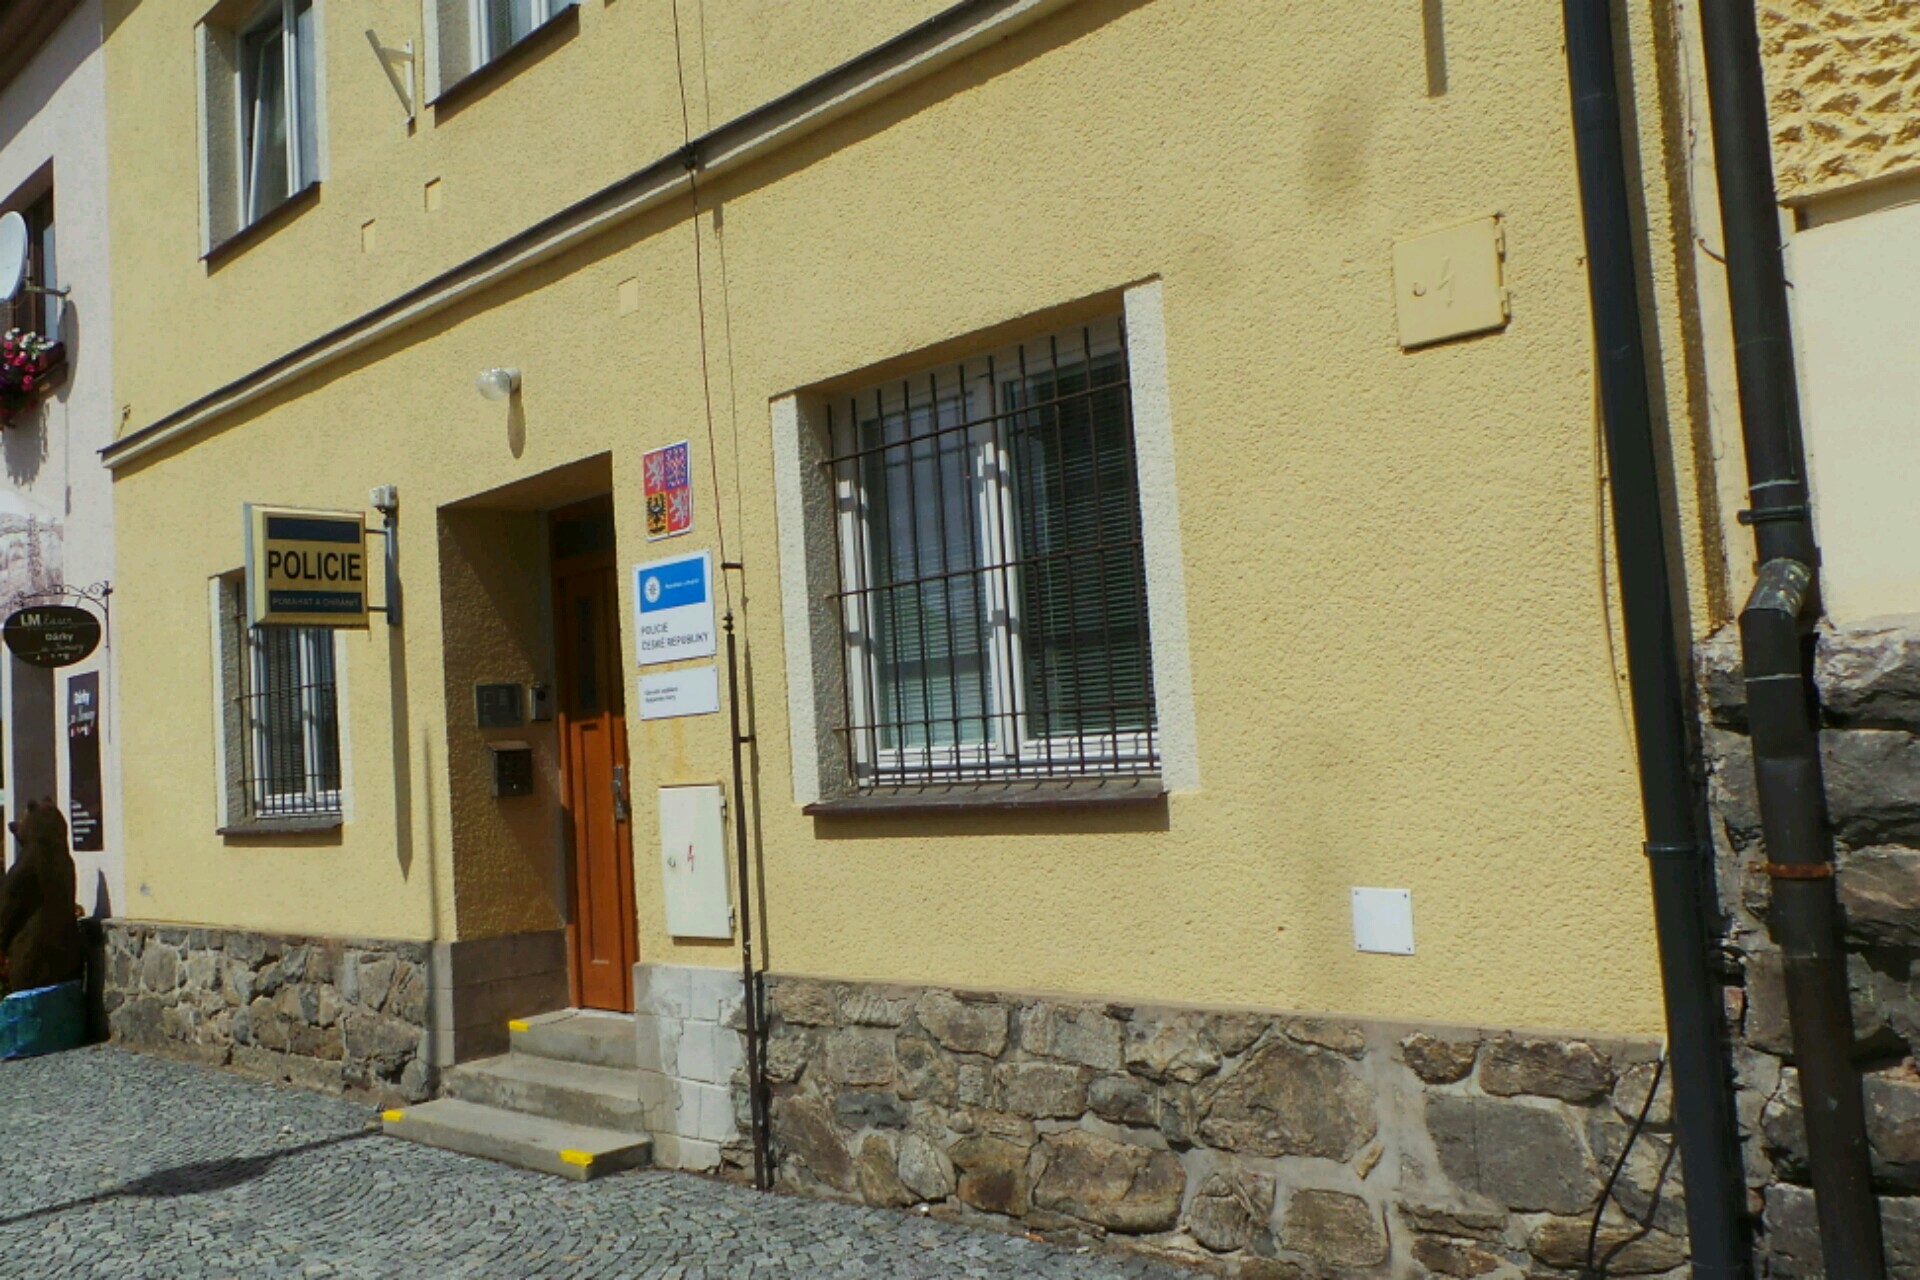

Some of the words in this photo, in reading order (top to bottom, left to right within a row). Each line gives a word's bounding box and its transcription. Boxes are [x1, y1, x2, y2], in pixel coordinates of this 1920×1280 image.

[268, 550, 362, 581] POLICIE
[21, 613, 42, 628] LM
[641, 622, 669, 637] POLICIE
[667, 631, 710, 647] REPUBLIKY
